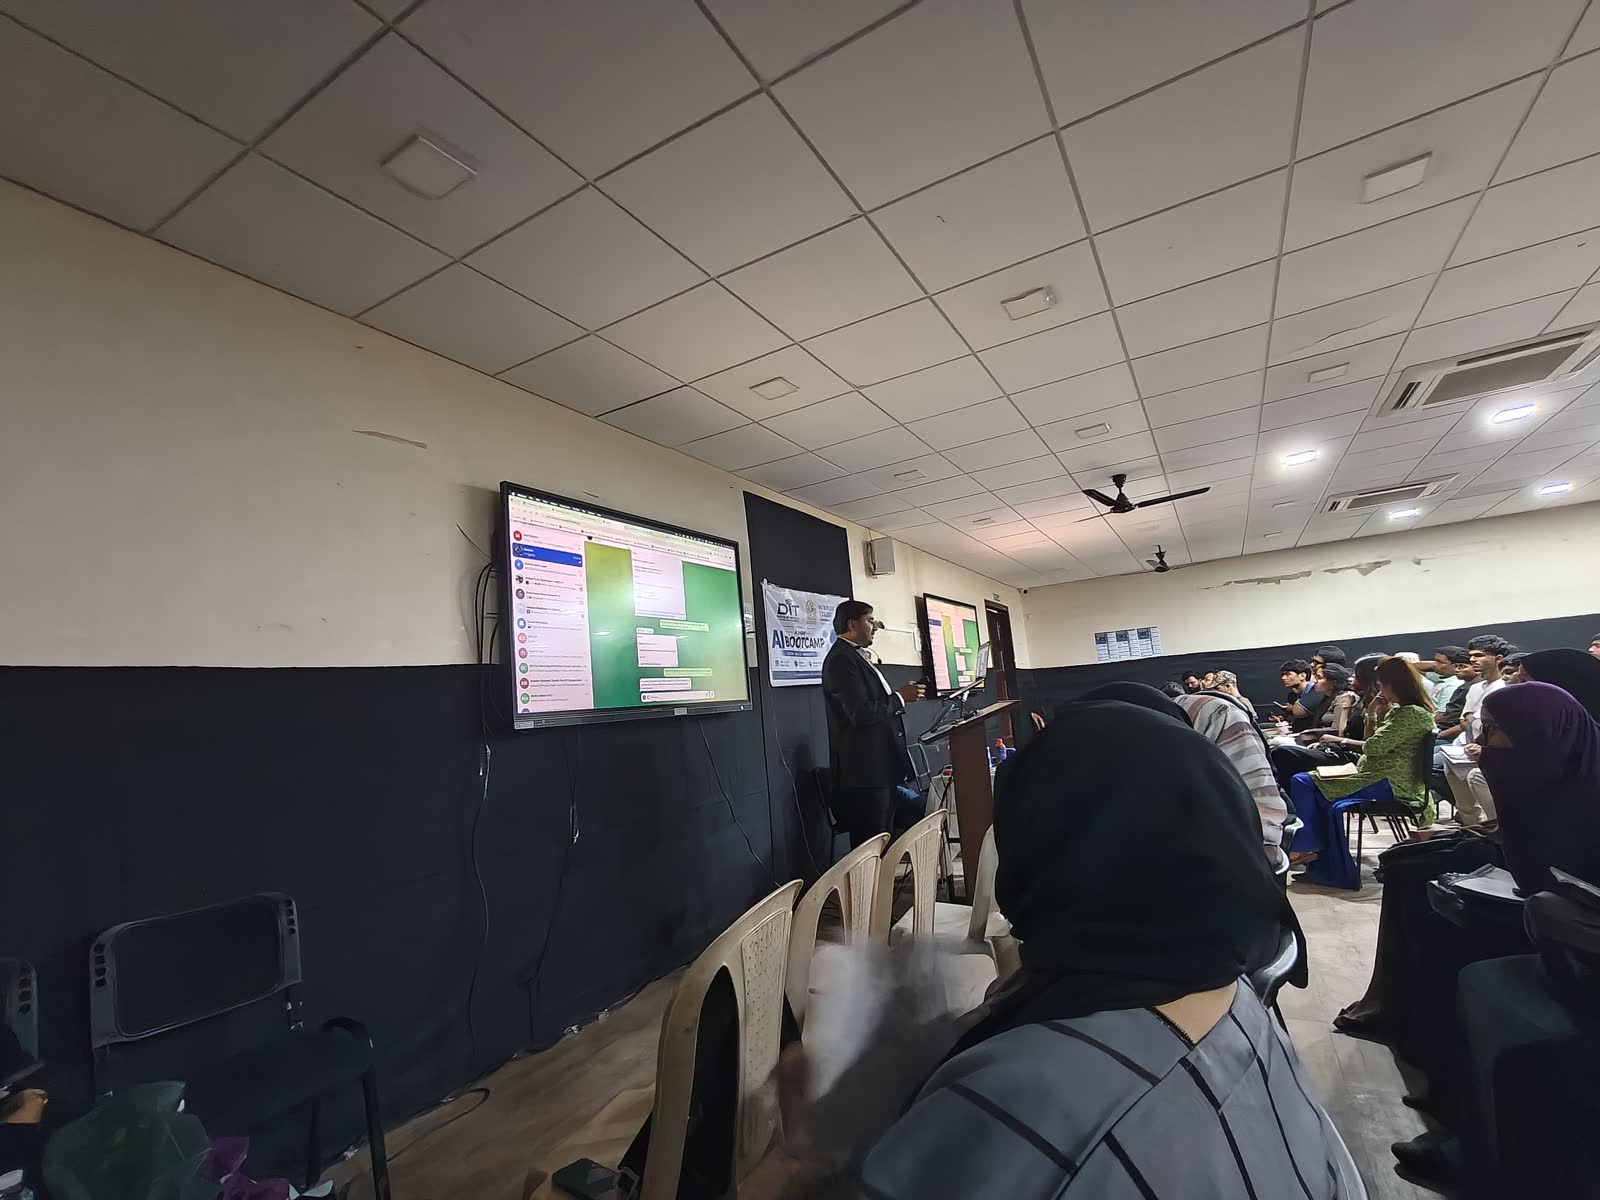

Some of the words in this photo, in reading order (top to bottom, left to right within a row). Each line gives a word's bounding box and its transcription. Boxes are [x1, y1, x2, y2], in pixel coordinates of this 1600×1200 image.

[777, 602, 799, 616] DIT
[772, 630, 785, 649] AI
[785, 636, 826, 649] BOOTCAMP
